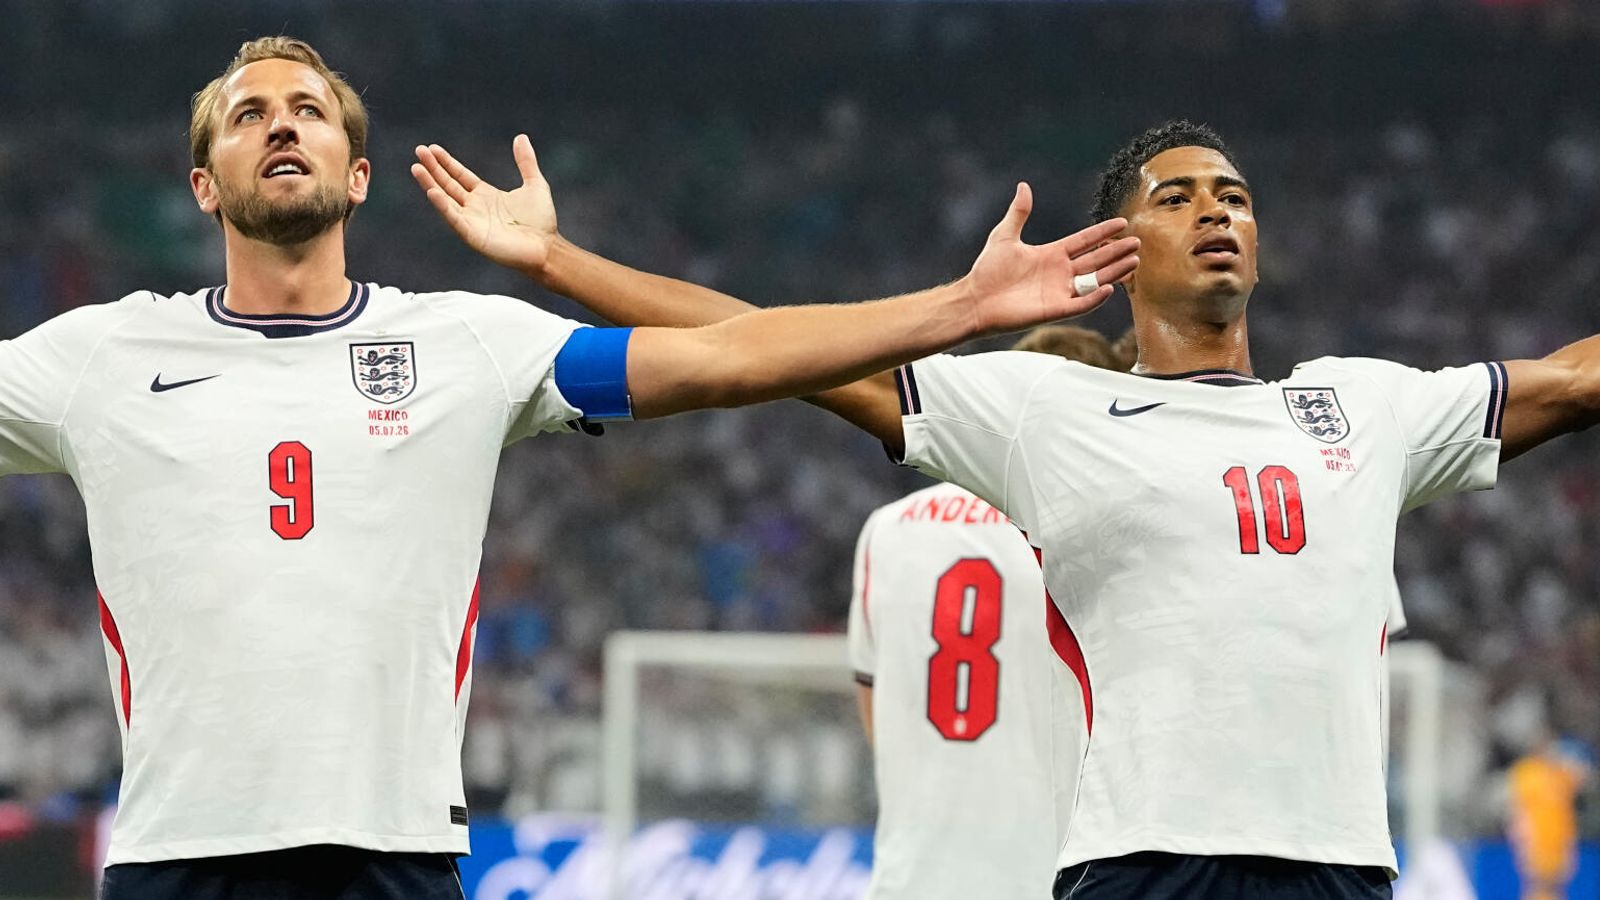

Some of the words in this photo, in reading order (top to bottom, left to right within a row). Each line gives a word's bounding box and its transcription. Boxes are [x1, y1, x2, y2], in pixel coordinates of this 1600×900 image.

[368, 409, 408, 421] MEXICO
[369, 425, 409, 436] 05.07.26
[268, 440, 314, 540] 9
[899, 496, 1011, 523] ANDER
[1222, 465, 1307, 555] 10
[927, 557, 1004, 741] 8
